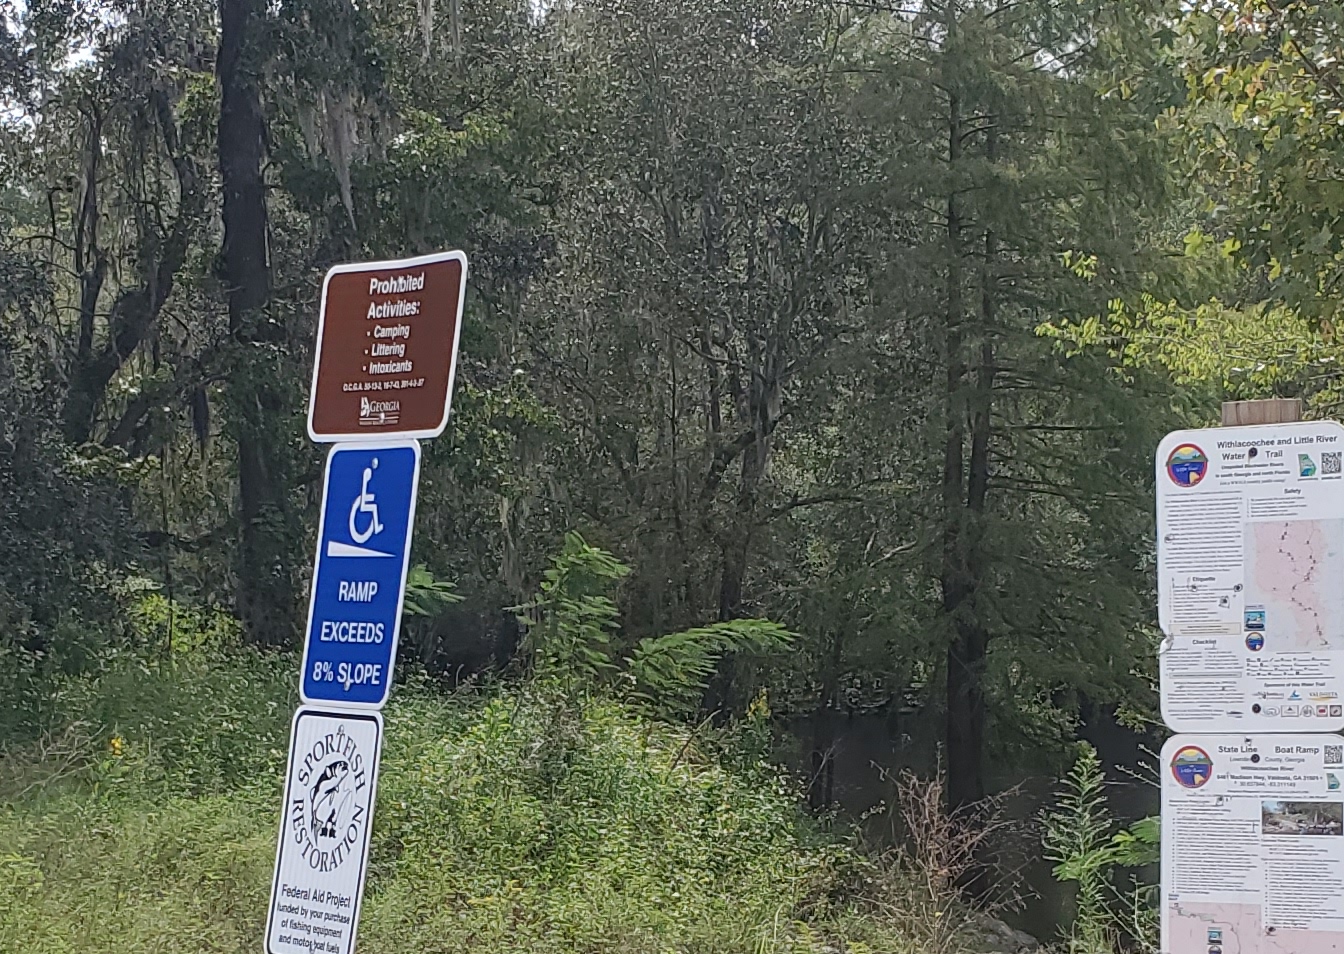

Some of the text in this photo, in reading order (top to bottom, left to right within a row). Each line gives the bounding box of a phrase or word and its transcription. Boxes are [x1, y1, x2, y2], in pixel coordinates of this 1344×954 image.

[369, 272, 424, 294] Prohibited
[367, 300, 420, 319] Activities:
[374, 324, 410, 340] Camping
[372, 342, 405, 357] Littering
[369, 360, 412, 374] Intoxicants
[370, 400, 400, 412] GEORGIA
[1217, 440, 1274, 449] Withlacoochee
[1294, 436, 1314, 444] Little
[1316, 435, 1337, 443] River
[1222, 450, 1282, 460] Water Trail
[339, 581, 378, 602] RAMP
[320, 622, 384, 644] EXCEEDS
[313, 661, 382, 685] 8% SLOPE
[1296, 746, 1319, 754] Ramp
[298, 732, 366, 794] SPORTFISH
[293, 799, 364, 872] RESTORATION
[282, 884, 351, 909] Federal Aid Project
[277, 902, 350, 924] funded by your purchase
[281, 919, 342, 939] of fishing equipment
[279, 934, 291, 944] and
[326, 941, 340, 954] fuels
